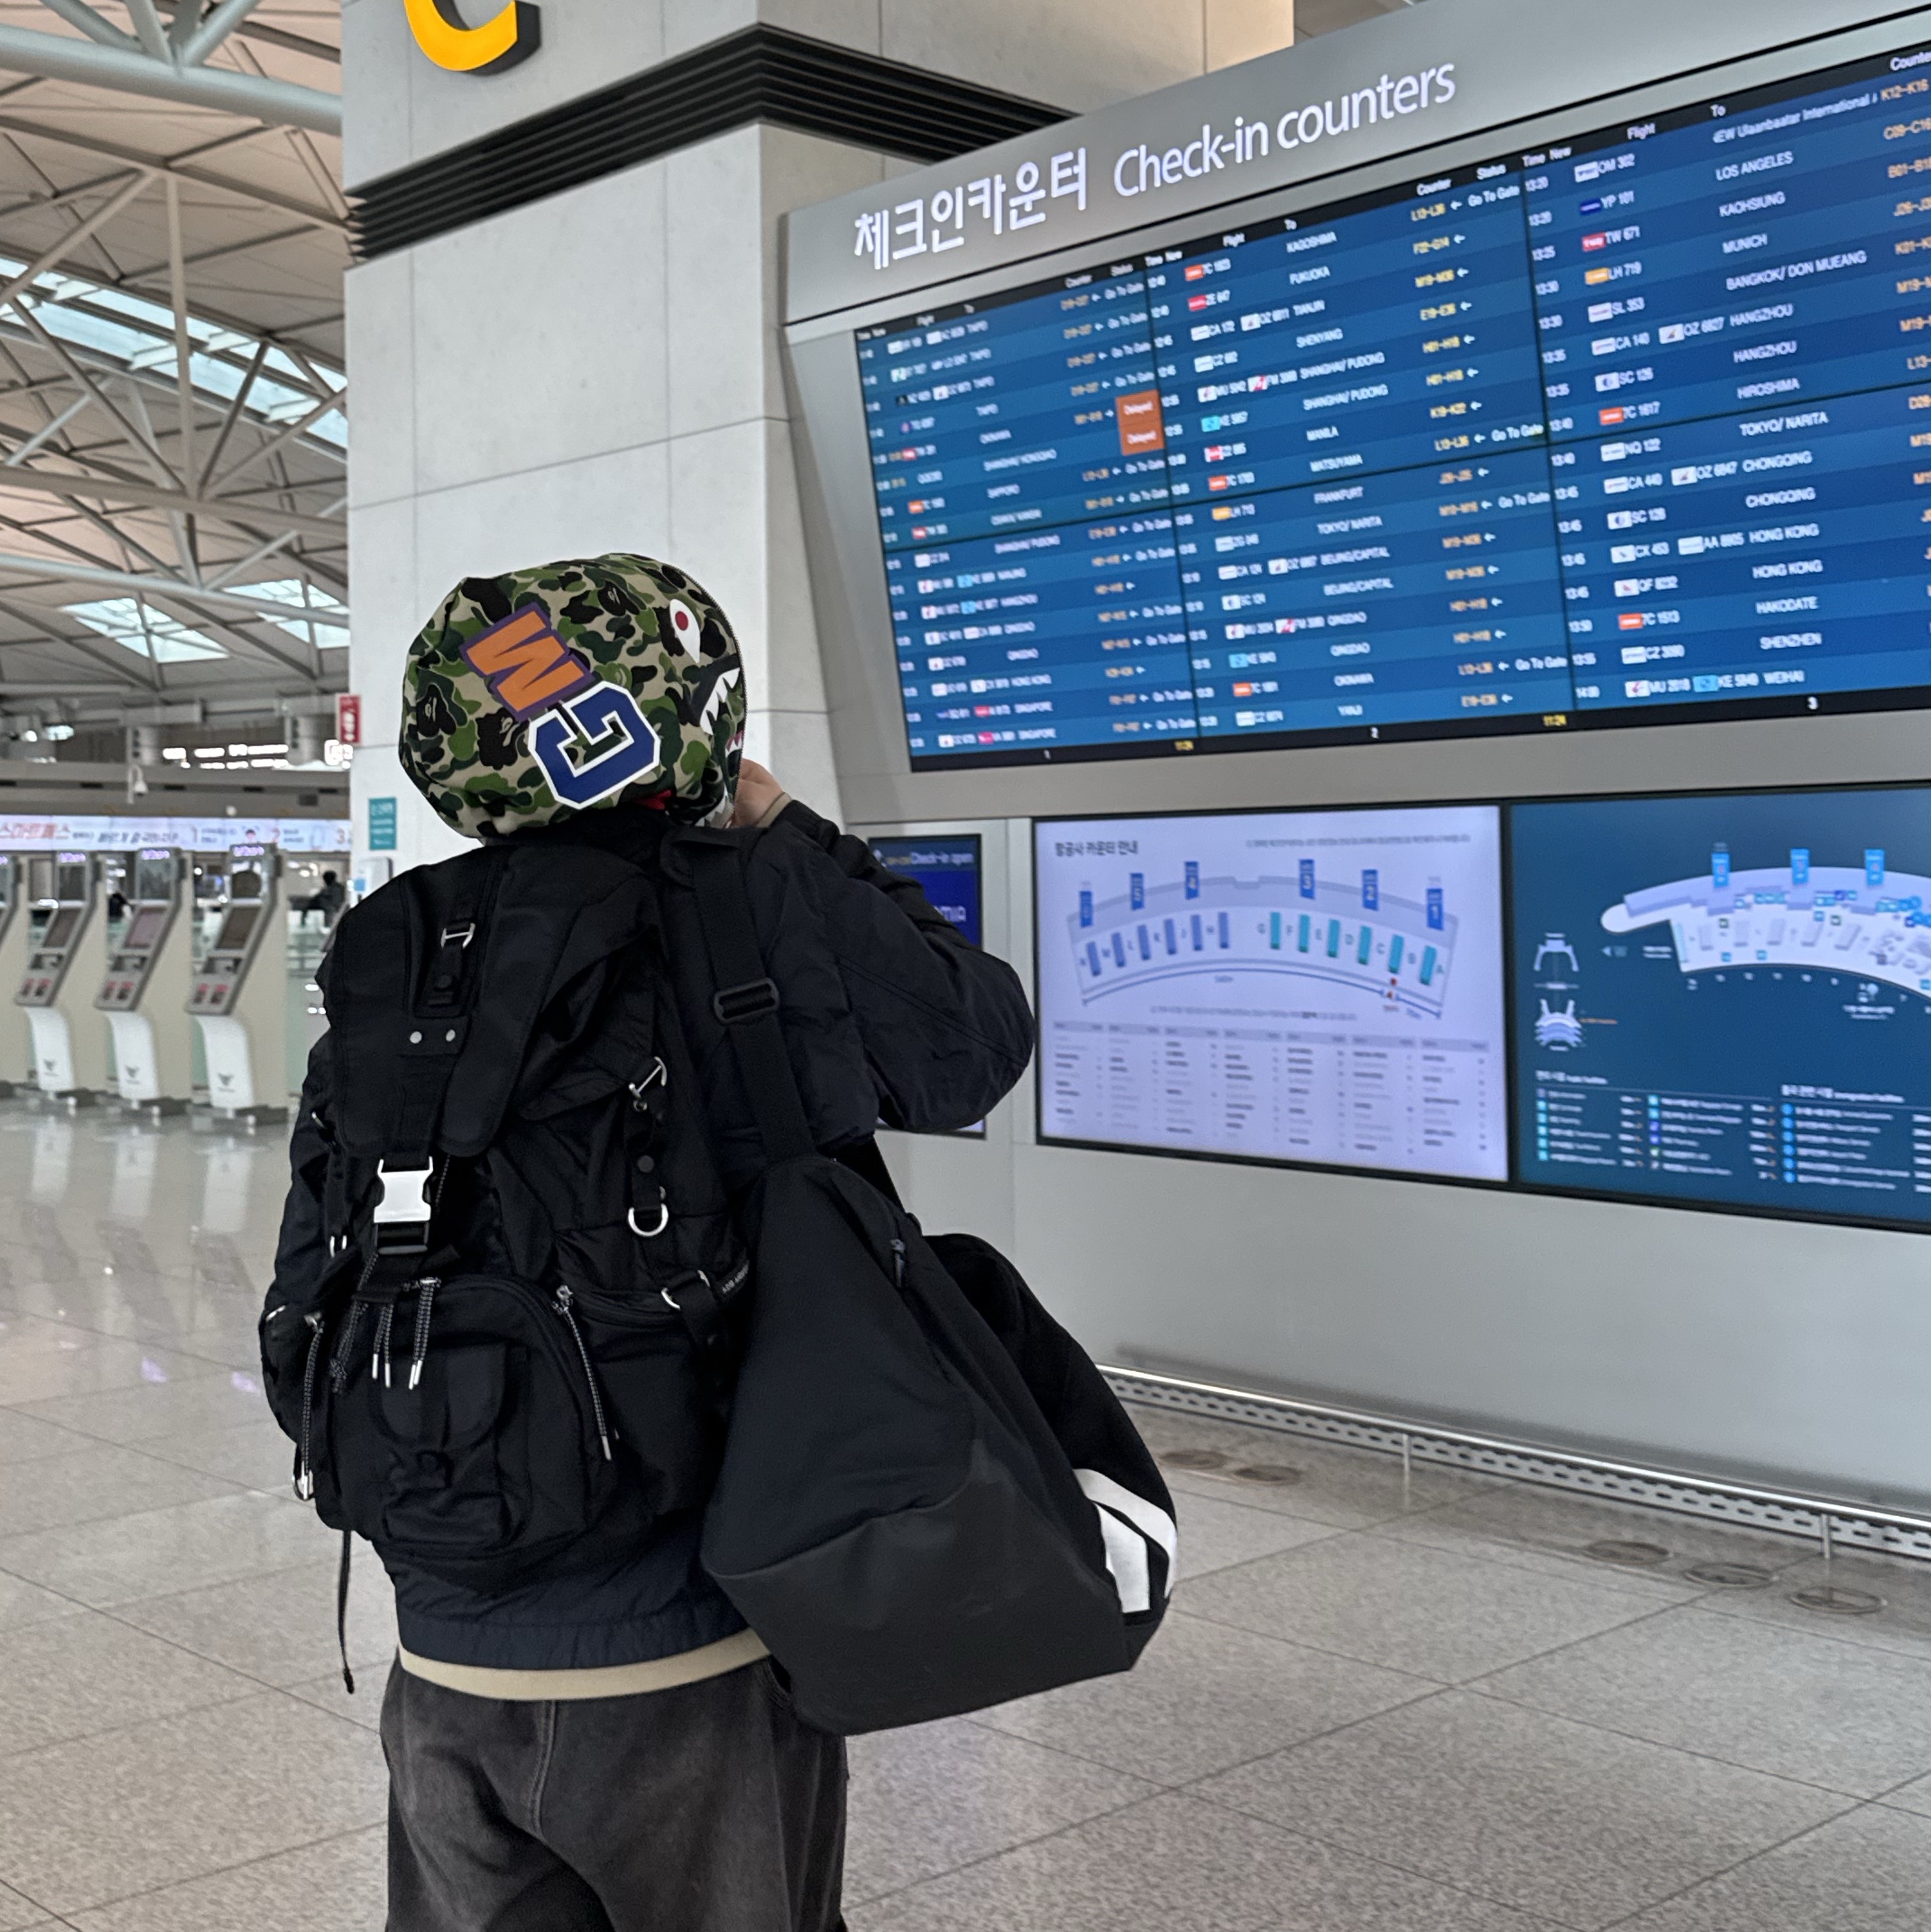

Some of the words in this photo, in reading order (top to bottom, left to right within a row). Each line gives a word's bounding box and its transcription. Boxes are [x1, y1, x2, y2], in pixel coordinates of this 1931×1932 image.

[1890, 52, 1931, 71] Counte
[1710, 104, 1726, 117] To
[1113, 117, 1268, 197] Check-in
[1276, 63, 1455, 150] counters
[1627, 123, 1655, 139] Flight
[1522, 154, 1545, 167] Time
[1716, 164, 1739, 181] LOS
[1741, 151, 1794, 174] ANGELES
[854, 148, 1086, 269] 체크인카운터
[1468, 194, 1483, 207] Go
[1601, 195, 1617, 208] YP
[1723, 234, 1767, 254] MUNICH
[1787, 262, 1814, 277] DON
[1815, 250, 1866, 271] MUEANG
[1730, 303, 1793, 326] HANGZHOU
[1733, 340, 1797, 363] HANGZHOU
[1737, 378, 1800, 399] HIROSHIMA
[1785, 411, 1829, 429] NARITA
[1492, 429, 1507, 441] Go
[1498, 496, 1513, 508] Go
[1749, 528, 1784, 543] HONG
[1784, 523, 1819, 538] KONG
[1753, 563, 1787, 578] HONG
[1788, 559, 1823, 574] KONG
[1756, 596, 1818, 614] HAKODATE
[1515, 658, 1530, 671] Go
[1055, 841, 1084, 856] 항공사
[1086, 840, 1116, 856] 카운터
[1118, 840, 1138, 855] 안내
[911, 852, 949, 865] Check-in
[951, 853, 974, 866] open
